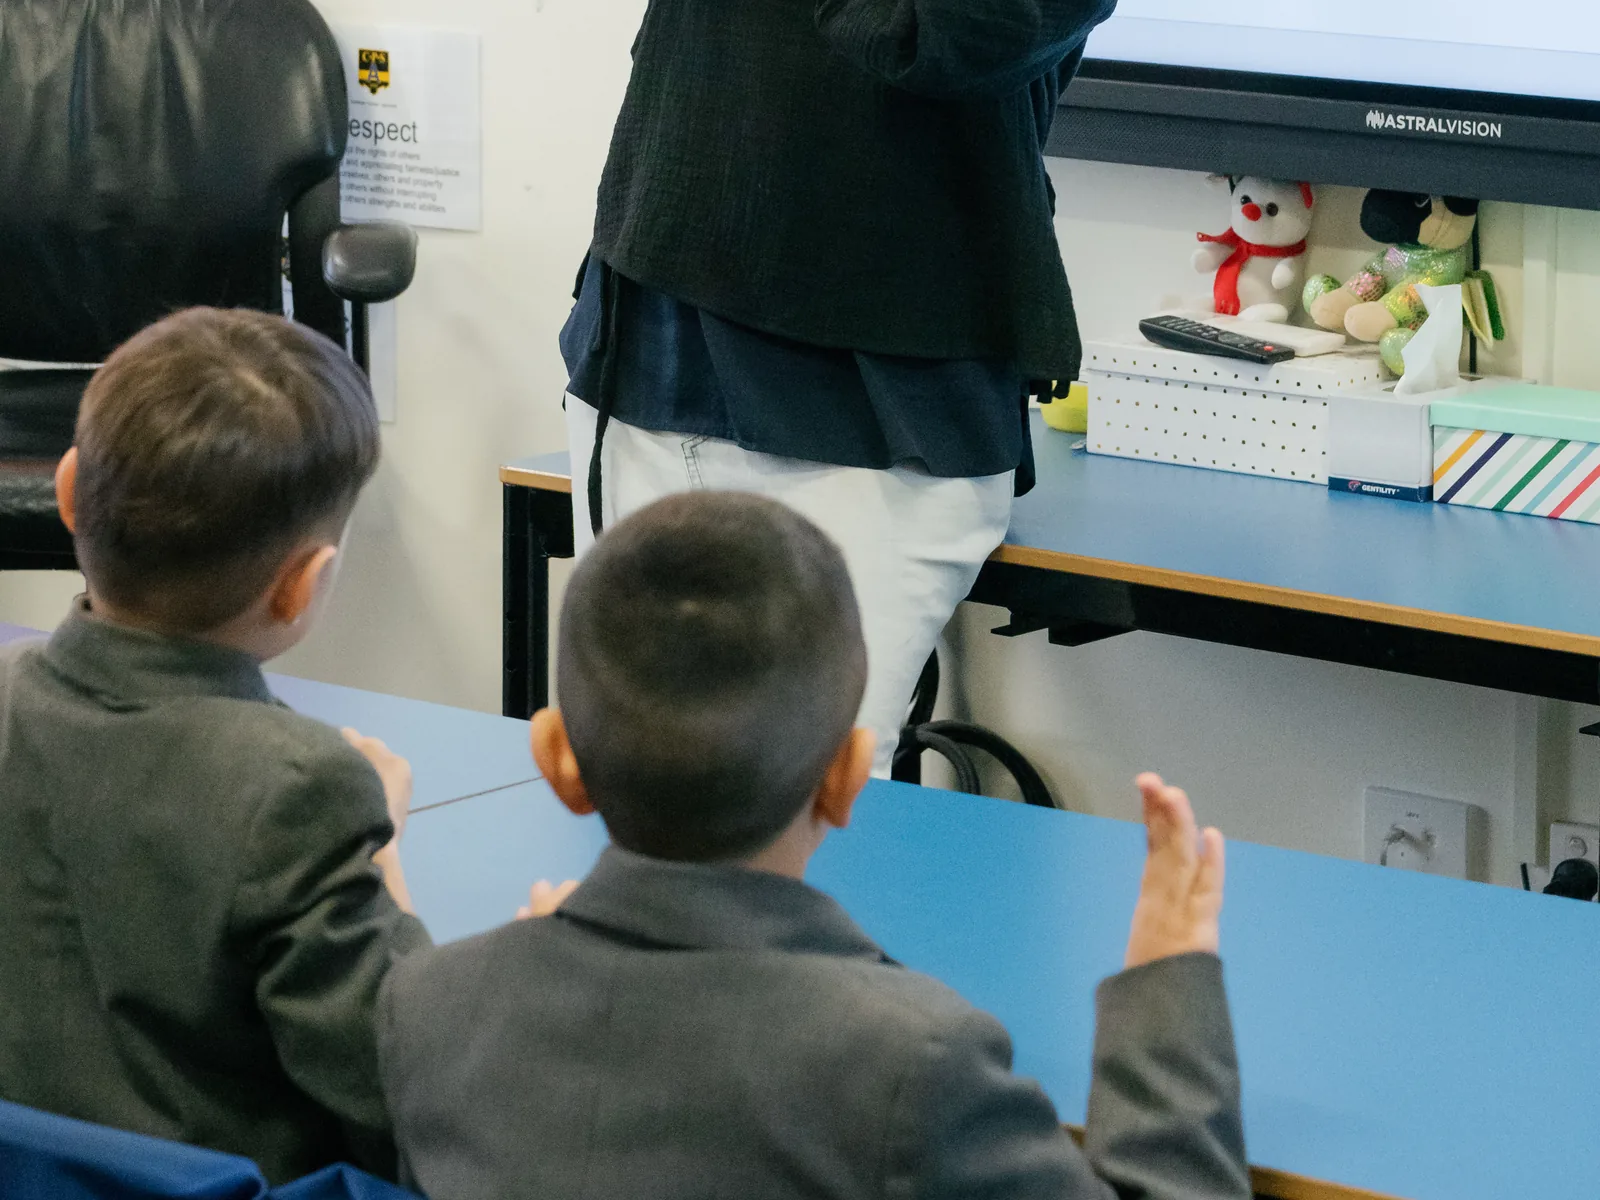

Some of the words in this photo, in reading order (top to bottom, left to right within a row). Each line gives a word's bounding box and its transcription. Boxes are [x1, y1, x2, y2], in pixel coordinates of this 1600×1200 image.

[349, 118, 418, 145] espect
[1384, 113, 1502, 138] ASTRALVISION
[1361, 484, 1396, 495] GENTILITY
